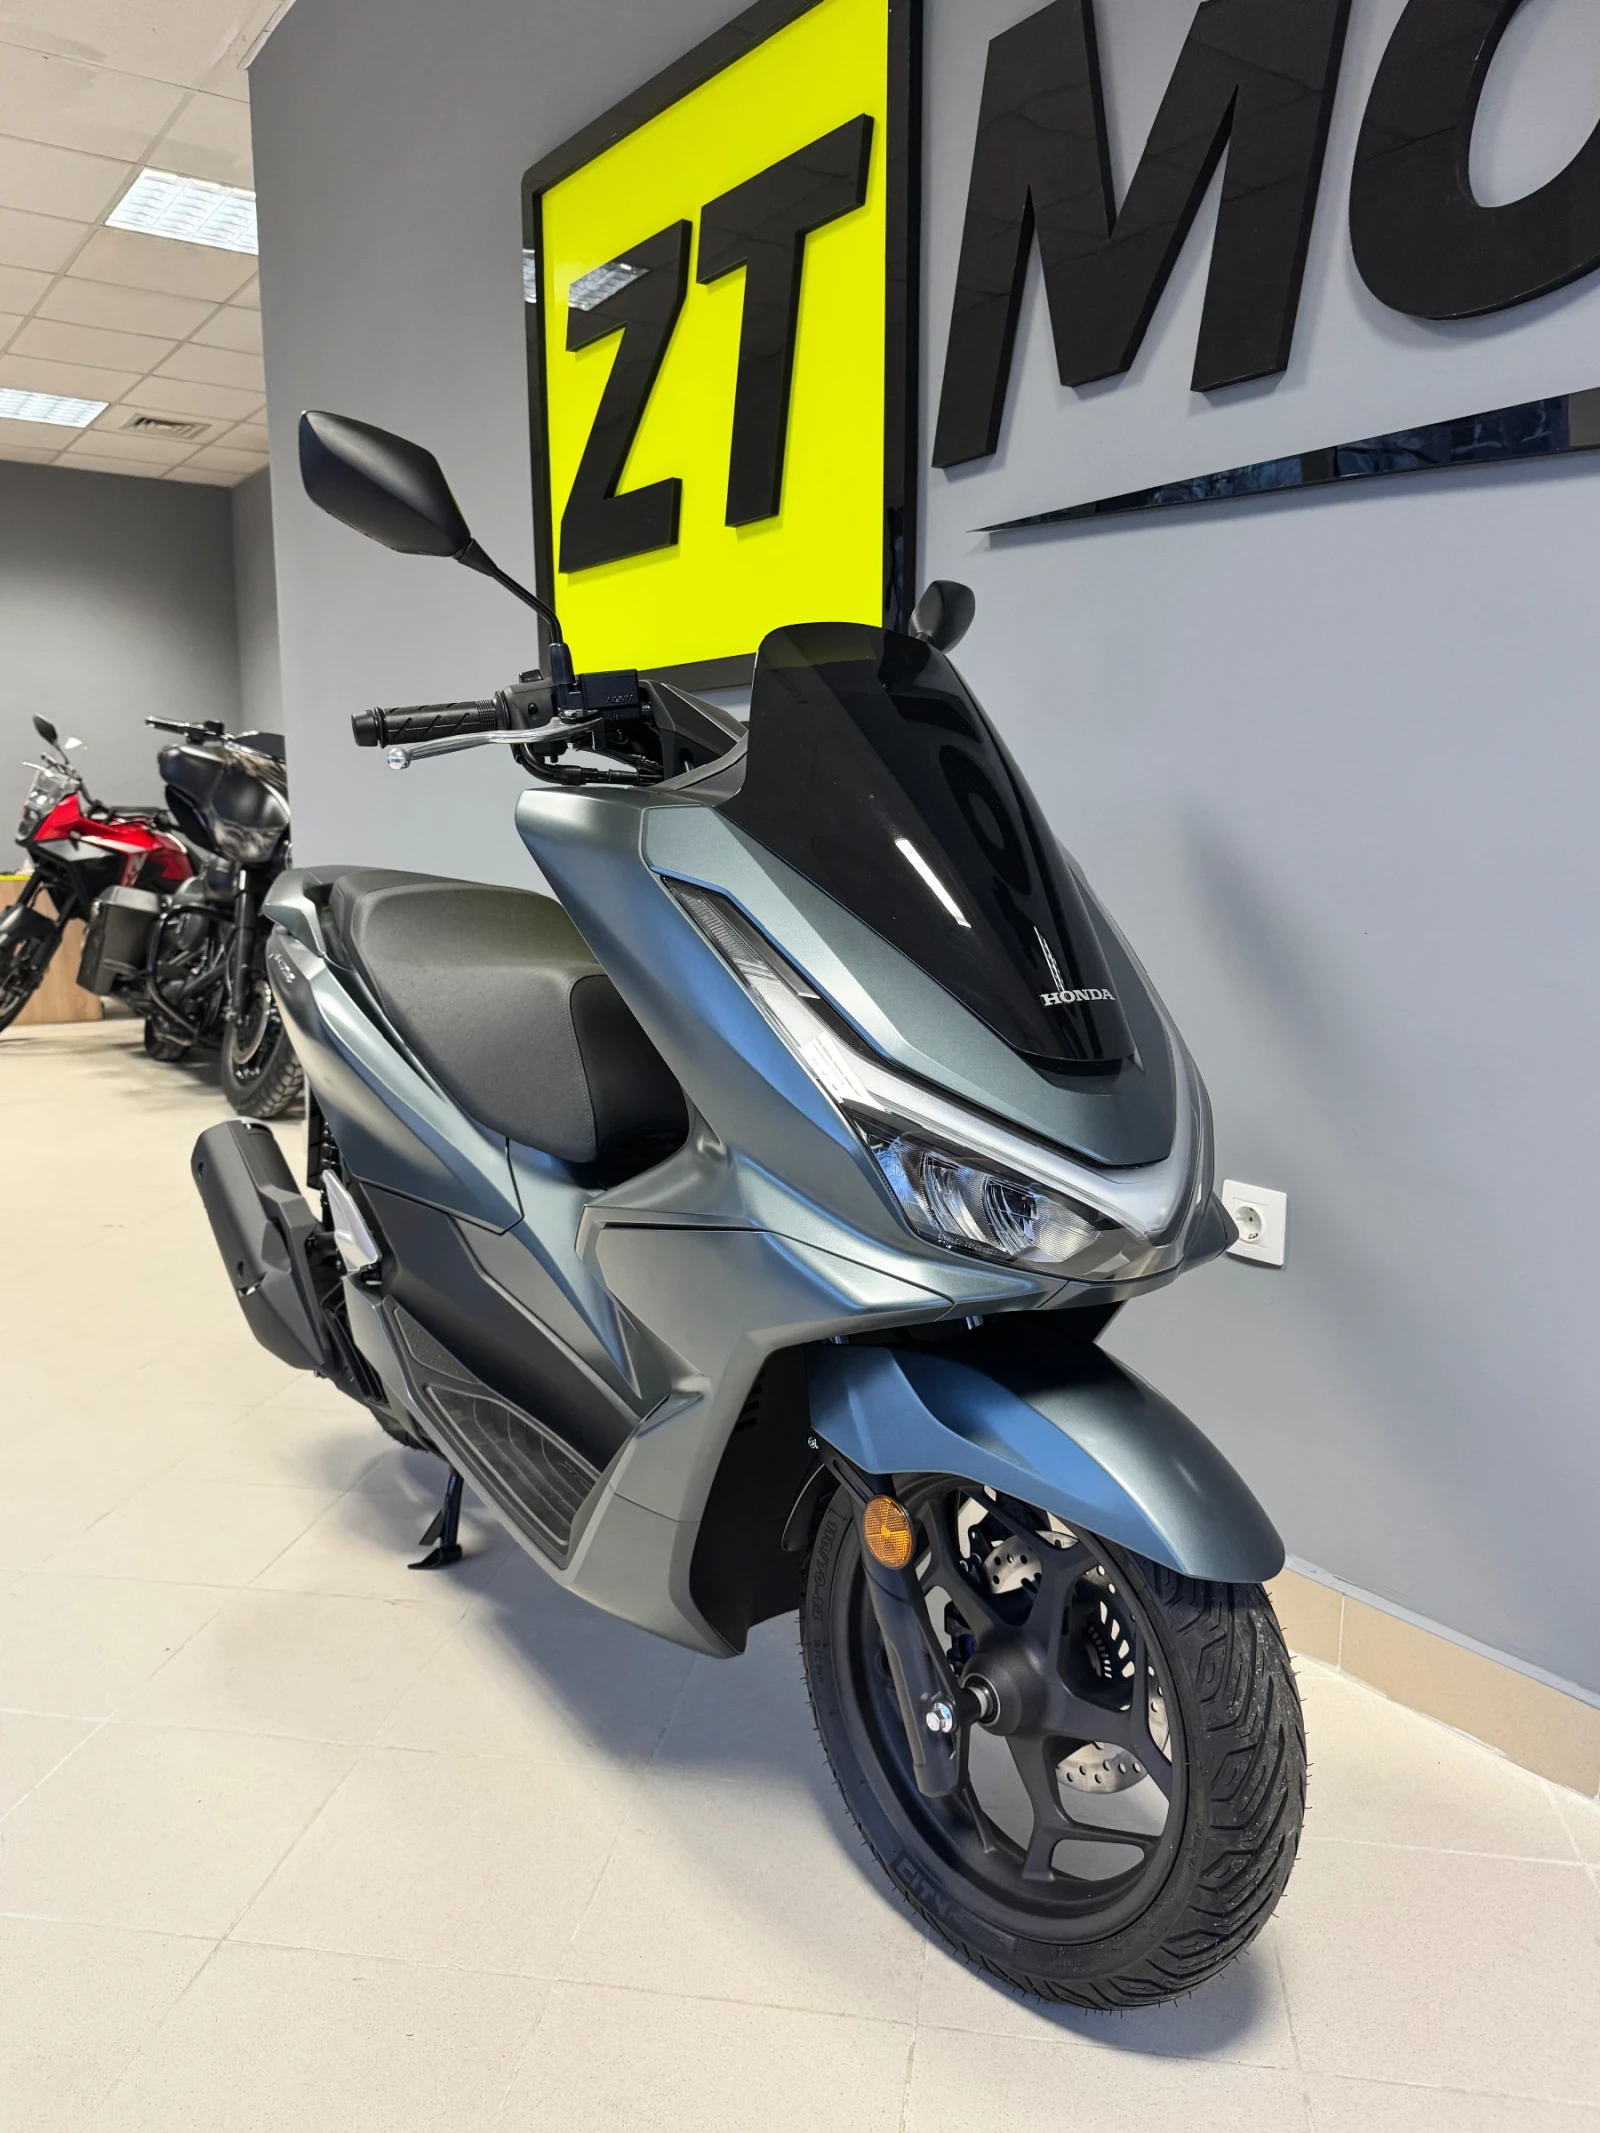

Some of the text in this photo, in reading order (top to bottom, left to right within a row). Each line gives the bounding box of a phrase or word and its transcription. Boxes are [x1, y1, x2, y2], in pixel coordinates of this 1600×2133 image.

[559, 113, 874, 573] ZT
[1040, 988, 1116, 1006] HONDA
[897, 1856, 950, 1917] CITY
